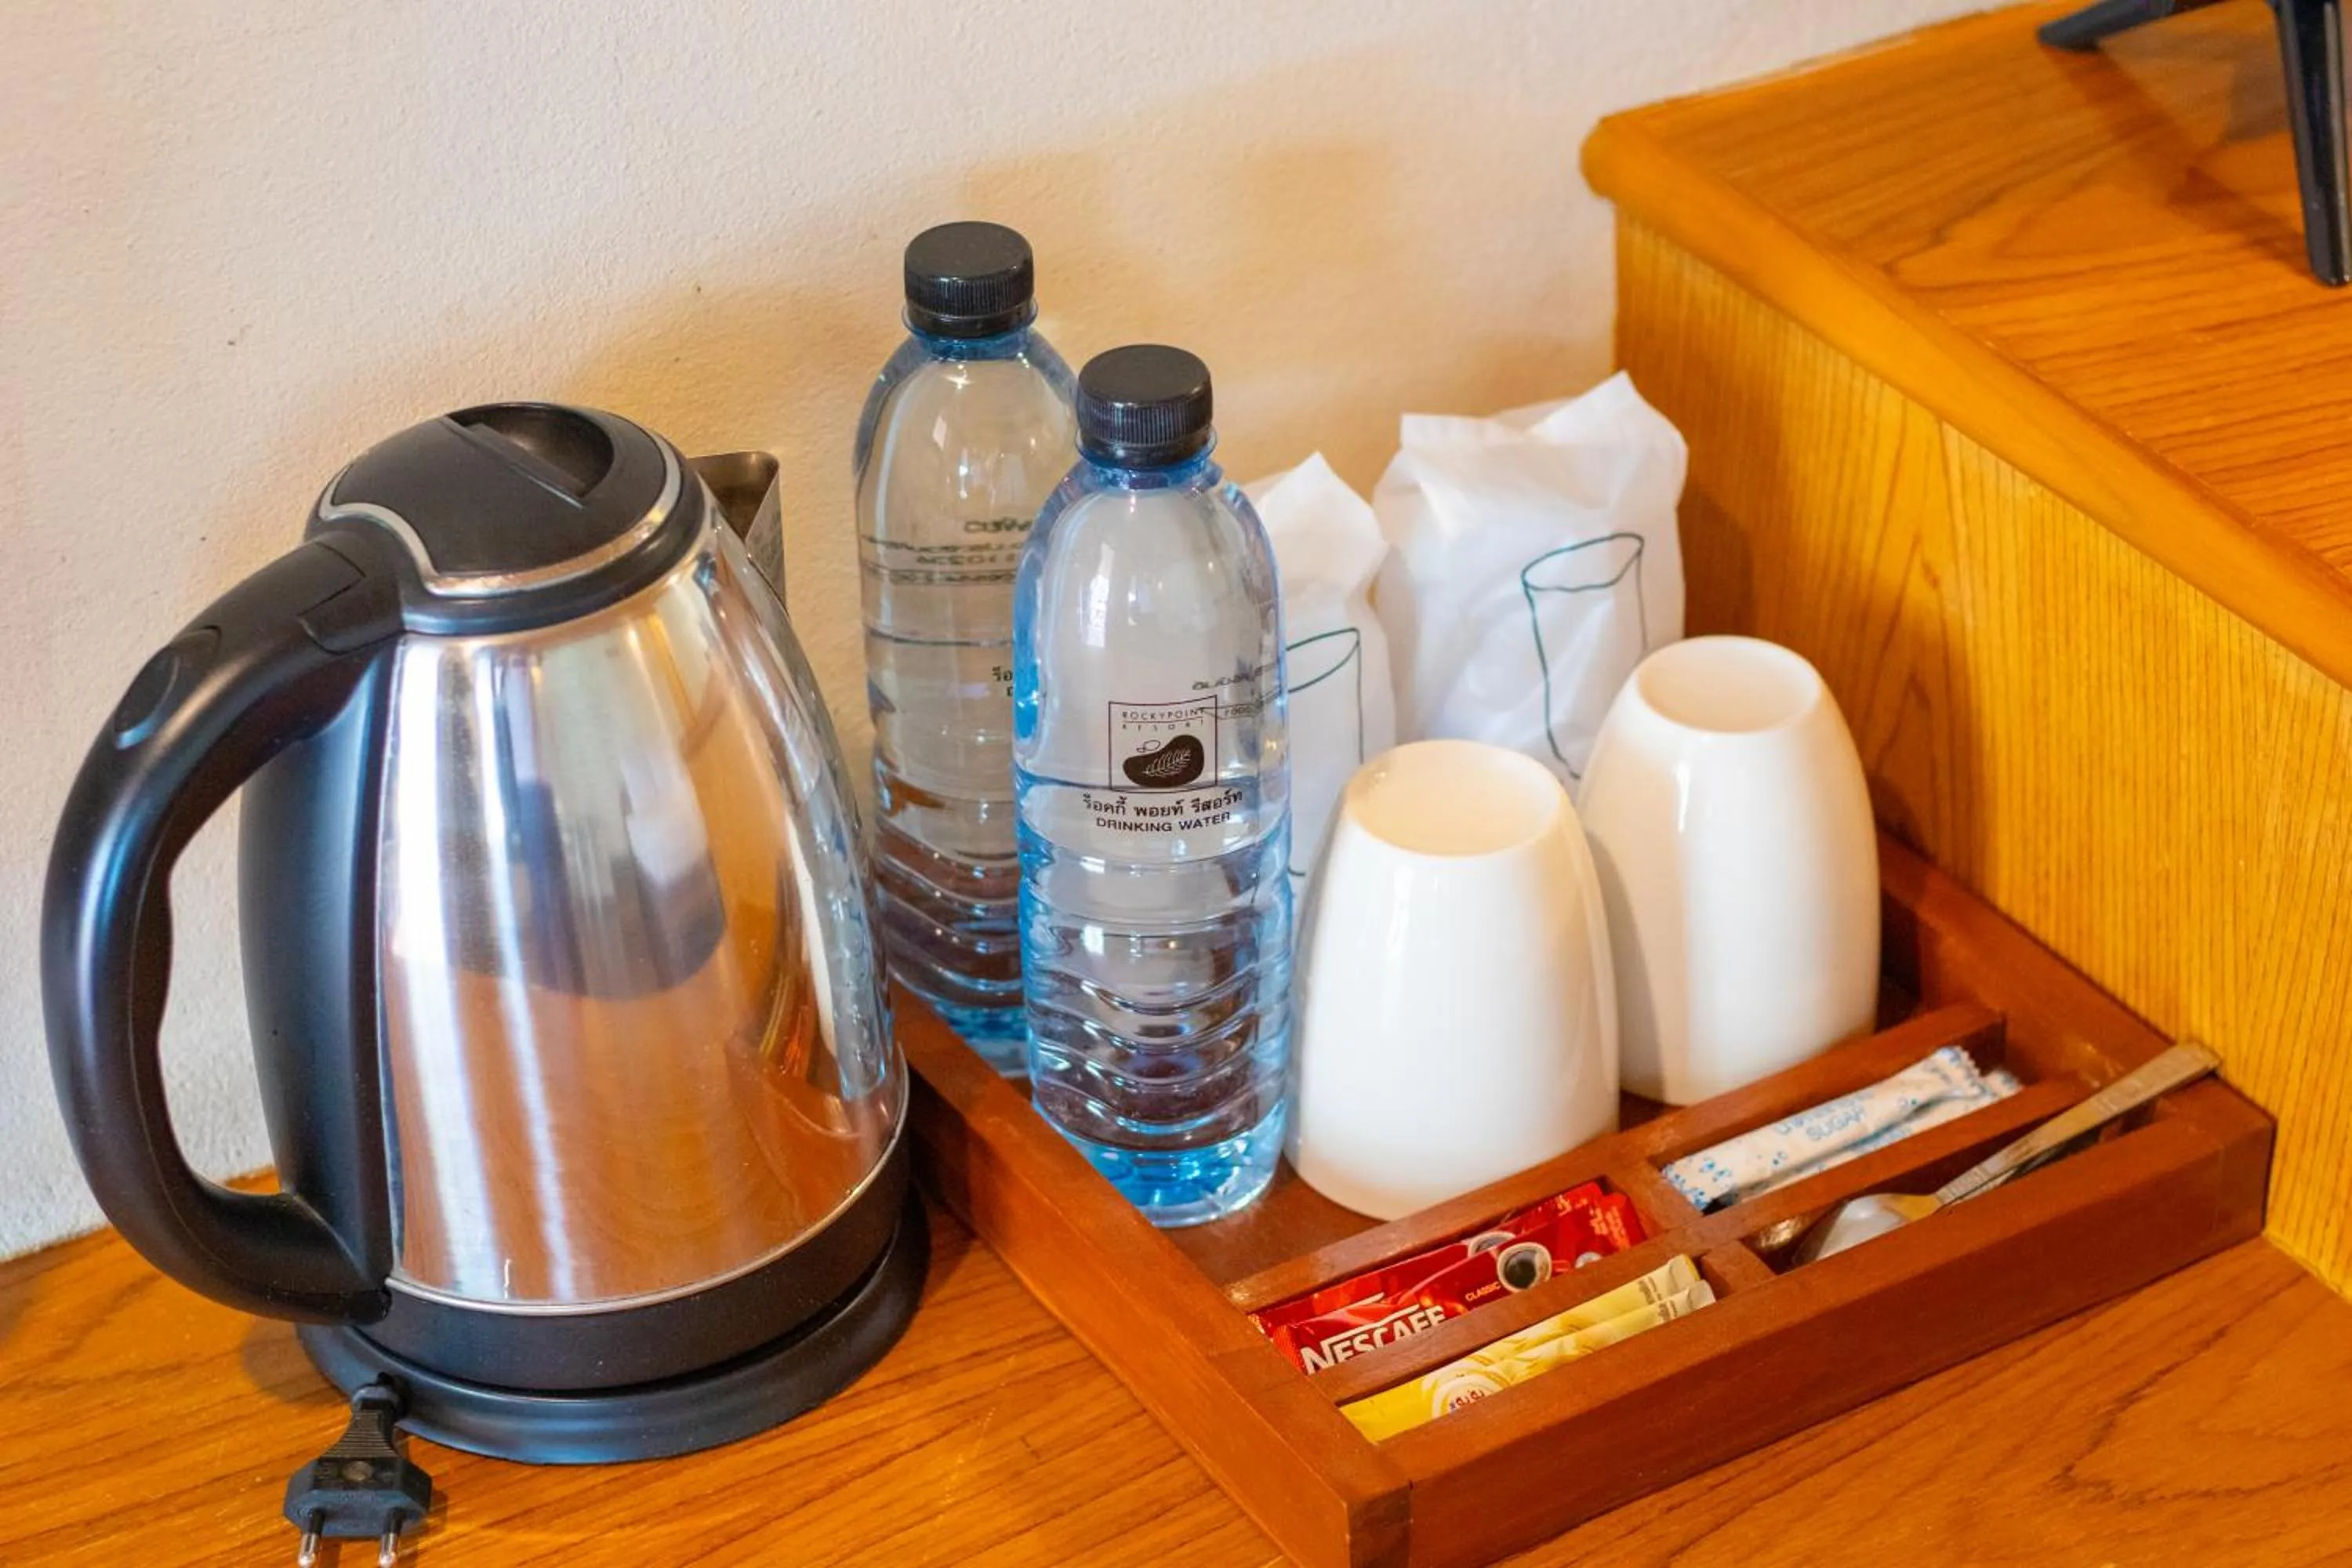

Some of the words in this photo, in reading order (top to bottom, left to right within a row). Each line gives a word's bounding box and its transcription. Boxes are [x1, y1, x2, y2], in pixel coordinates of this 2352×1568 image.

[1122, 707, 1203, 720] ROCKYPOINT
[1134, 799, 1185, 817] พอยท์
[1095, 817, 1172, 832] DRINKING
[1178, 811, 1230, 830] WATER
[1465, 1279, 1501, 1301] CLASSIC
